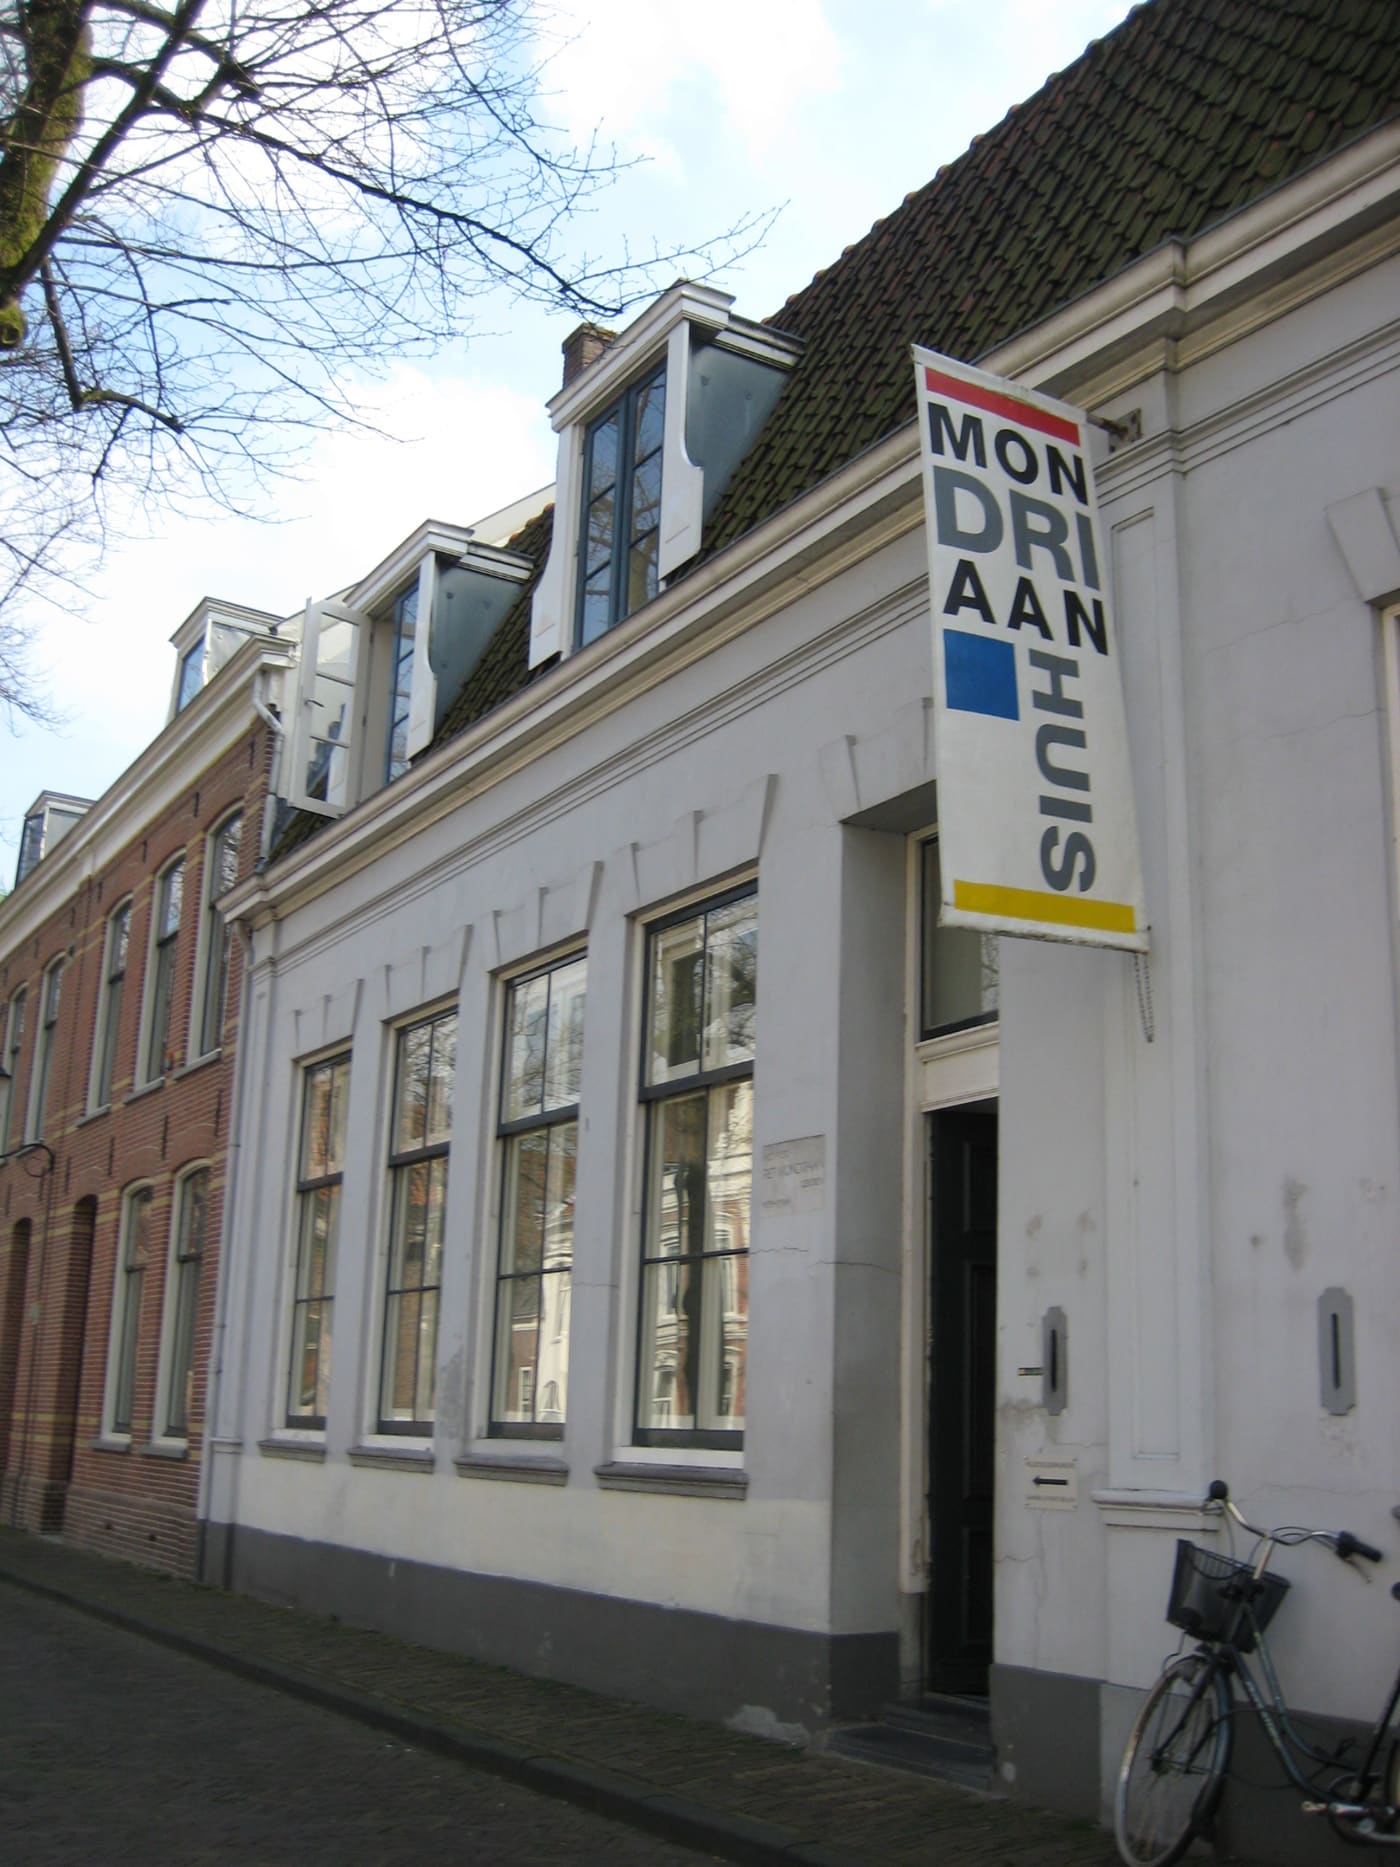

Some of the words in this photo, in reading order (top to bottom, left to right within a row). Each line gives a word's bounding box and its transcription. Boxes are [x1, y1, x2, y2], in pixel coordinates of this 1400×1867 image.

[926, 401, 1088, 505] MON
[932, 465, 1101, 593] DRI
[942, 558, 1109, 656] AAN
[1028, 648, 1098, 893] HUIS
